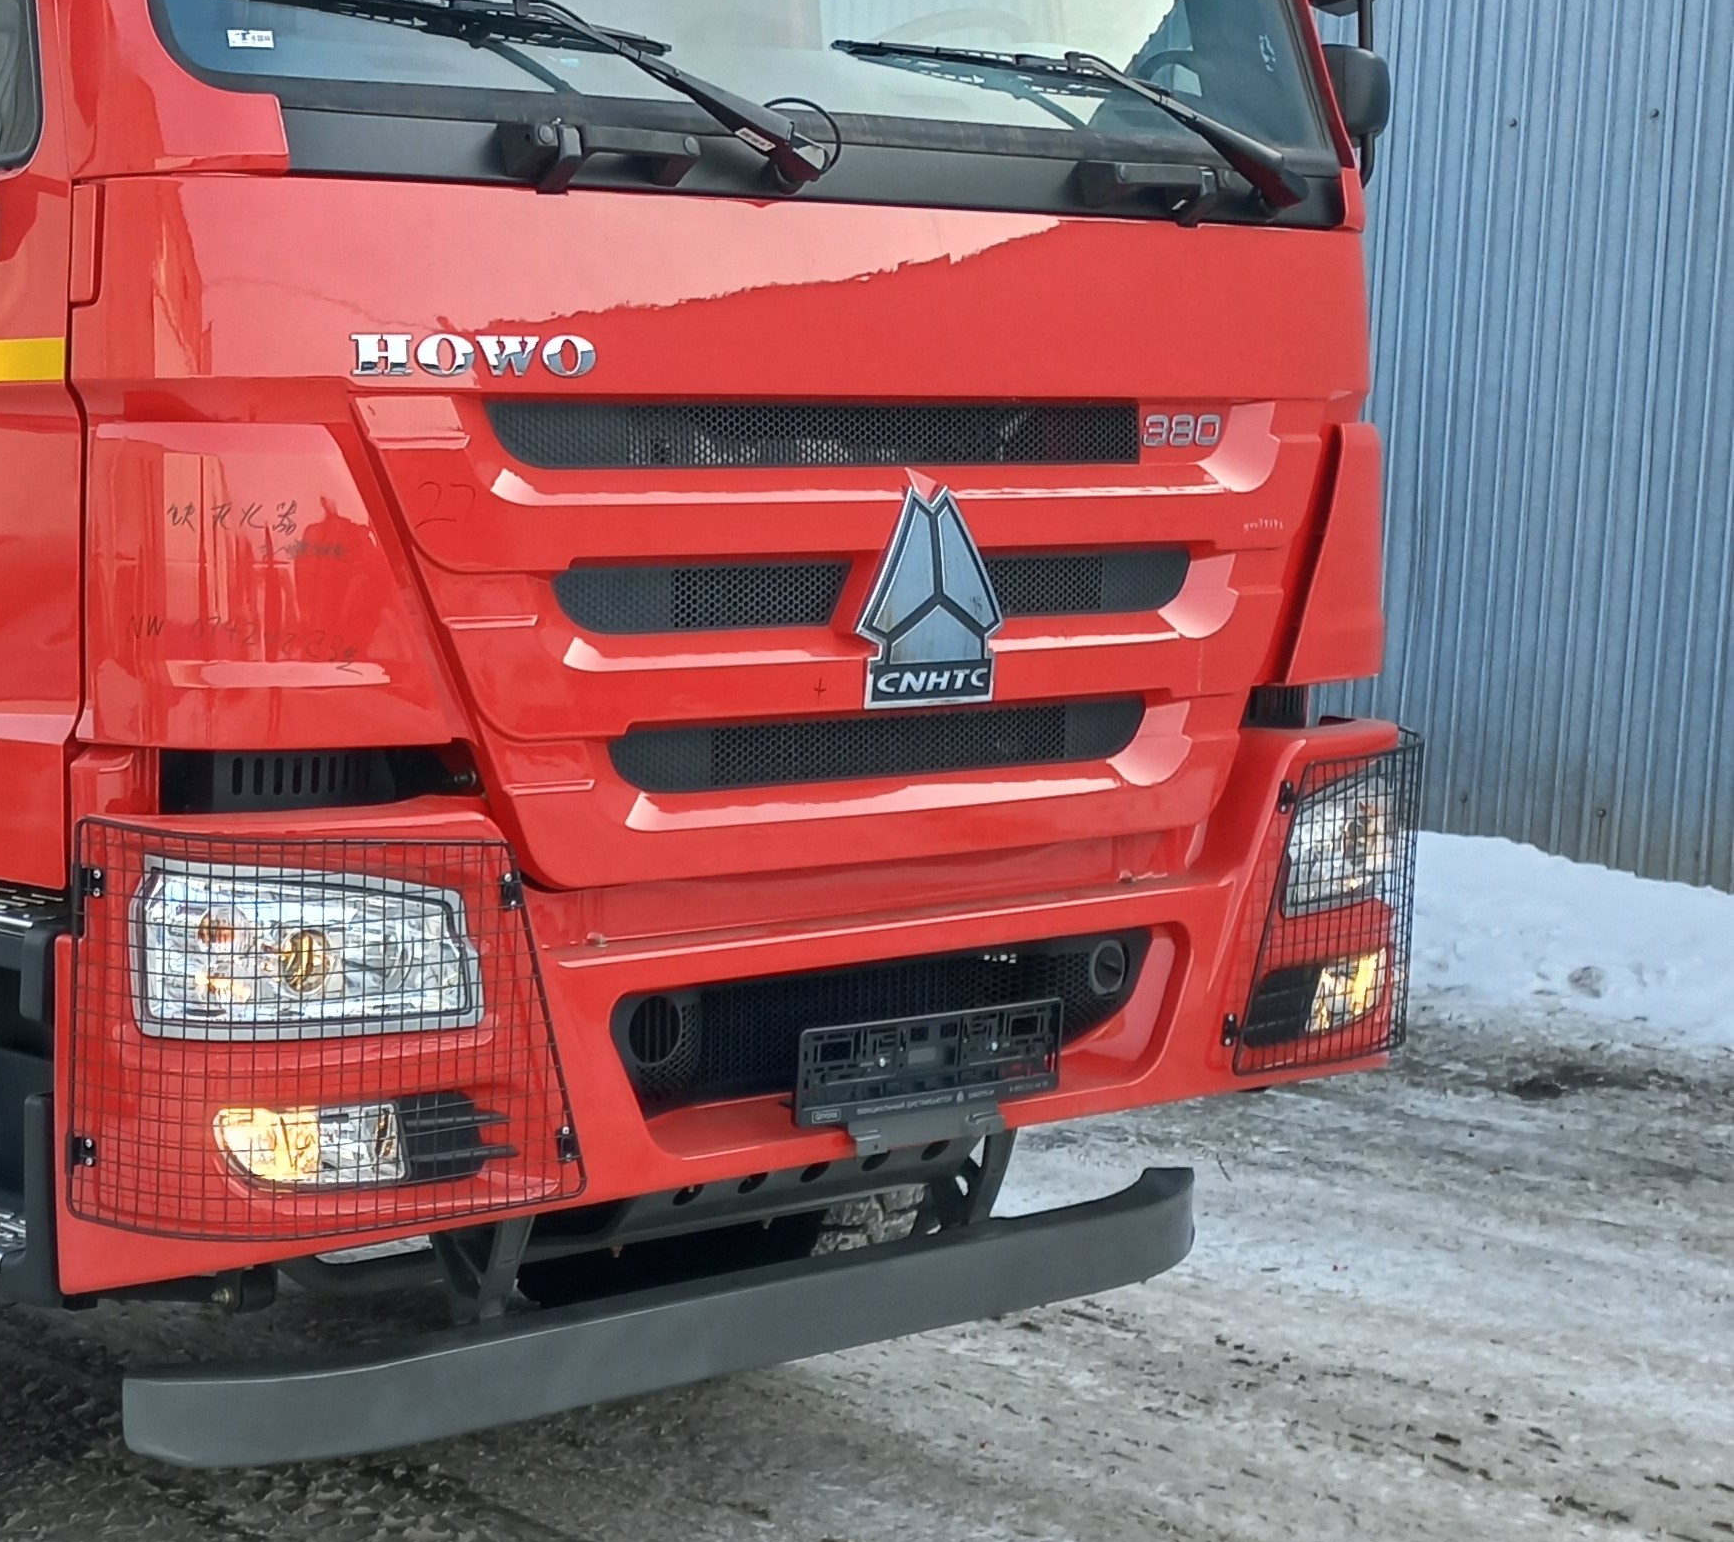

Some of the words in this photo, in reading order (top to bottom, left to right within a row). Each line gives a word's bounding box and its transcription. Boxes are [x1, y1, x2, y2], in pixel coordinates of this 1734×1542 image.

[349, 333, 597, 377] HOWO
[1143, 414, 1221, 447] 380
[876, 667, 988, 693] CNHTC
